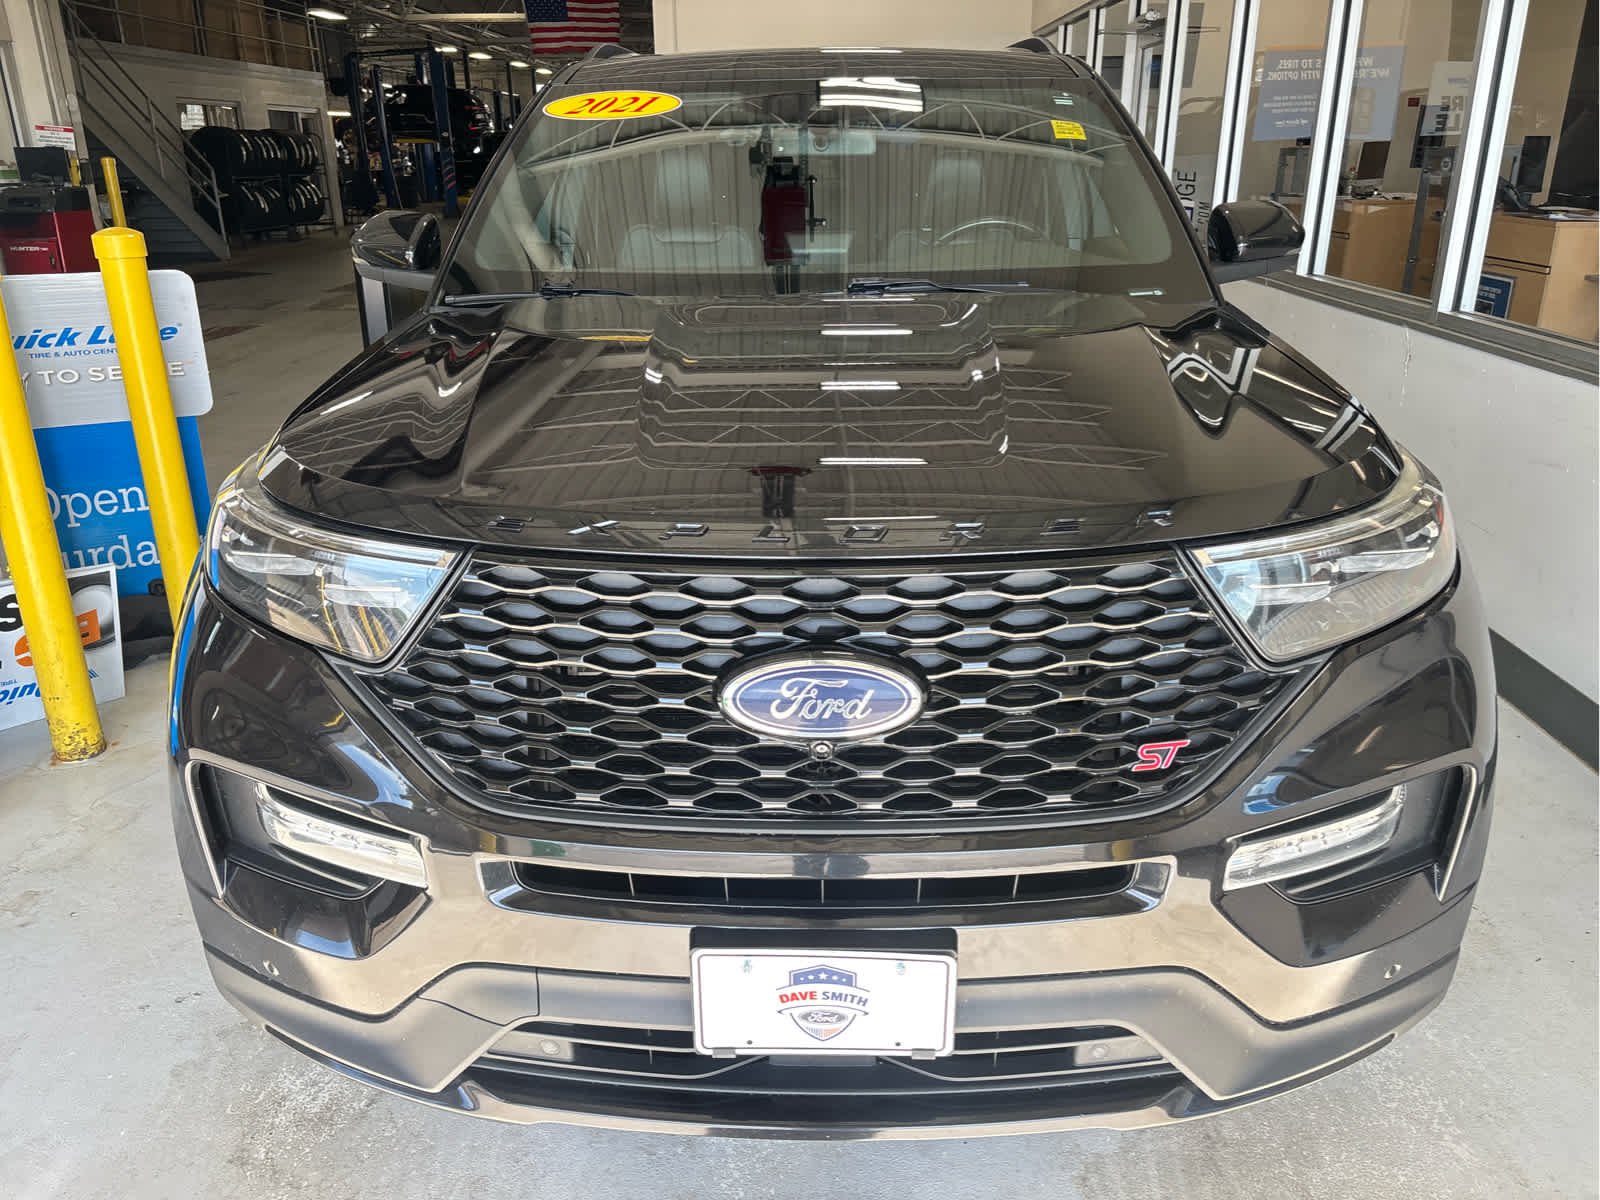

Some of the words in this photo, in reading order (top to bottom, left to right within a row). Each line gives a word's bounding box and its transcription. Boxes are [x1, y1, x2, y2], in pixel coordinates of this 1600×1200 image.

[564, 96, 661, 115] 2021
[12, 327, 81, 350] uick
[37, 369, 80, 385] TO
[487, 510, 1175, 545] EXPLORER
[770, 677, 875, 720] Ford
[1131, 739, 1192, 772] ST
[778, 990, 818, 1004] DAVE
[821, 991, 869, 1007] SMITH
